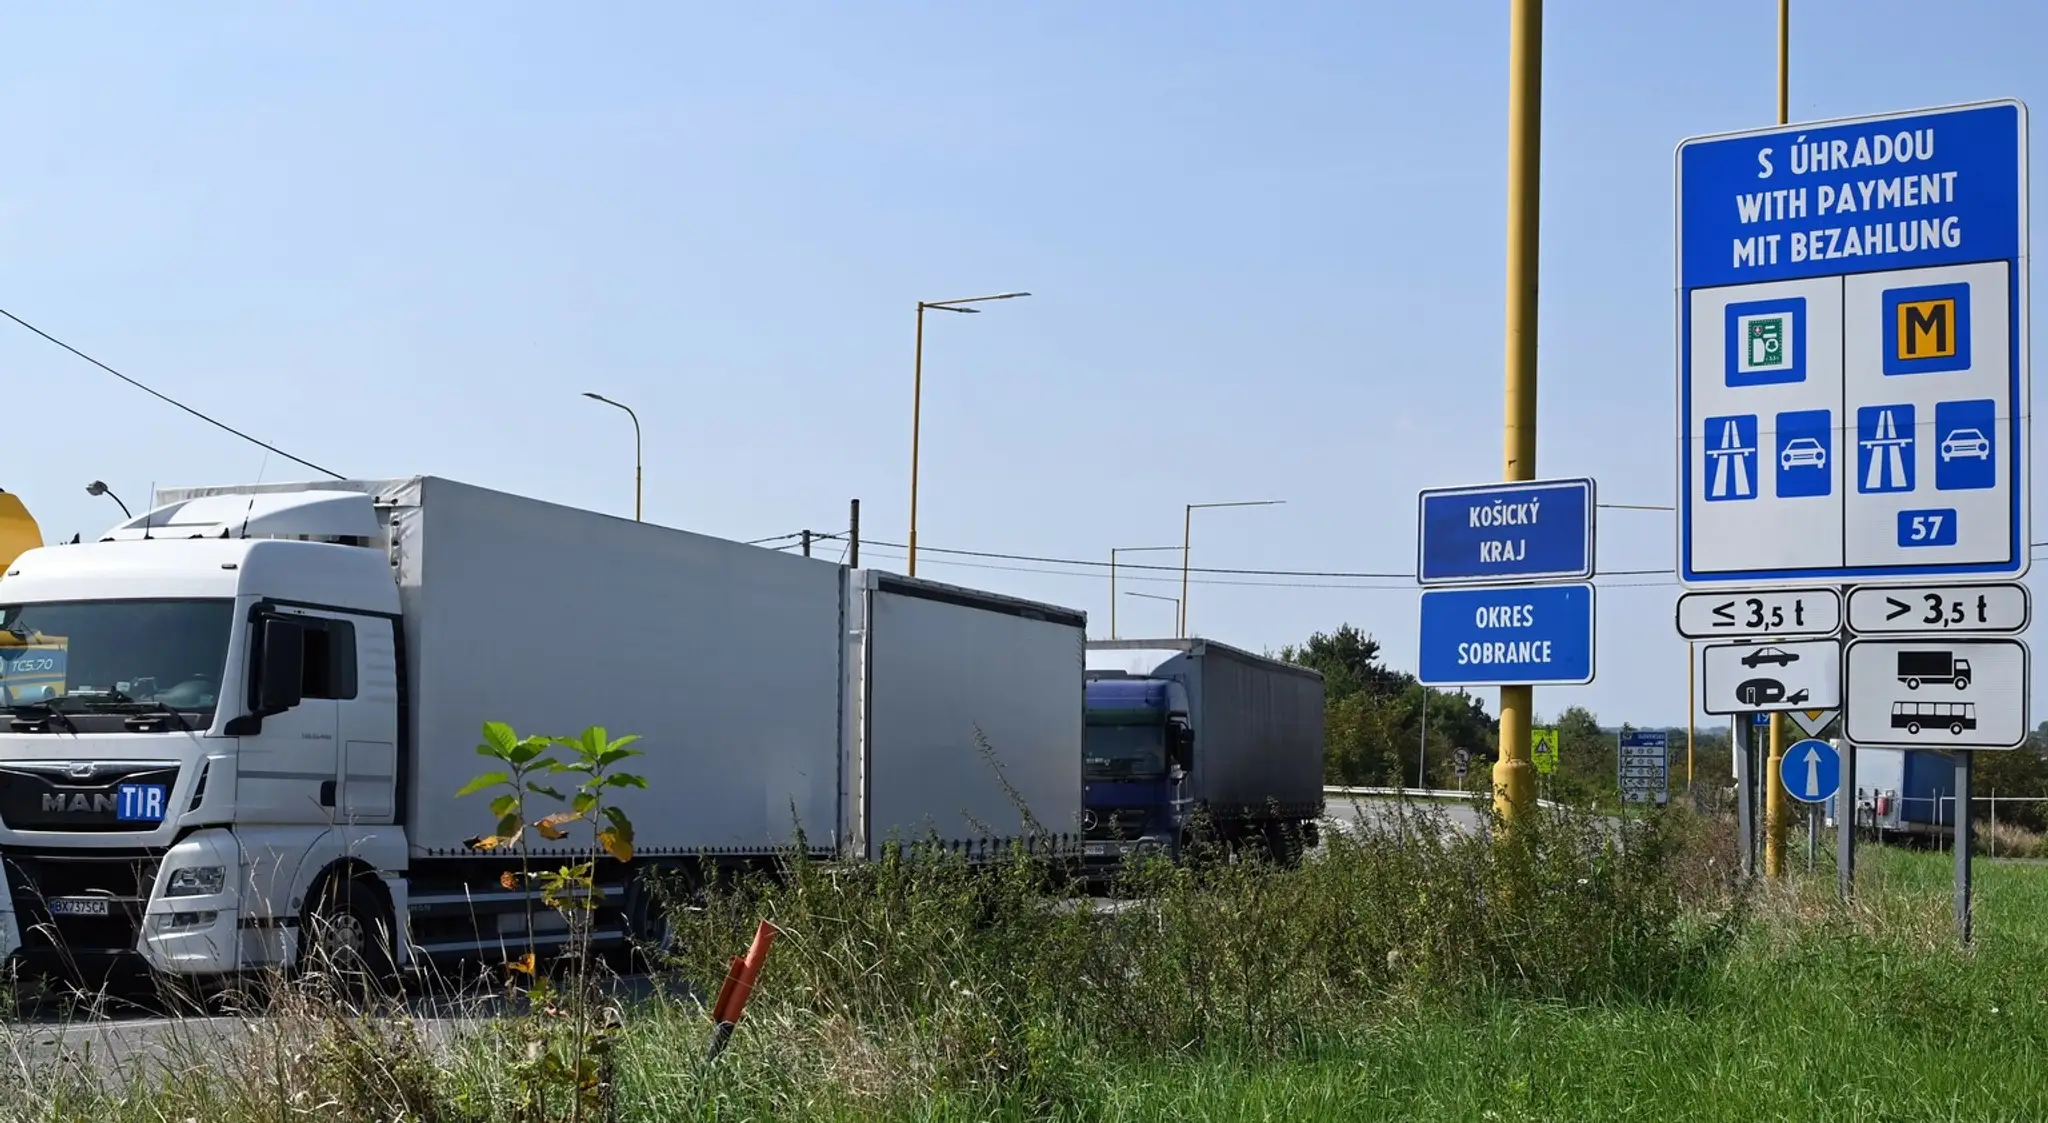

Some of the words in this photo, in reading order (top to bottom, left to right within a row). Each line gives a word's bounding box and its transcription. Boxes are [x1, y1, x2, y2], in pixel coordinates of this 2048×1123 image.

[1758, 148, 1773, 179] S
[1790, 129, 1934, 175] ÚHRADOU
[1736, 187, 1807, 224] WITH
[1818, 171, 1958, 215] PAYMENT
[1733, 235, 1781, 268] MIT
[1791, 216, 1961, 263] BEZAHLUNG
[1905, 304, 1946, 354] M
[1469, 497, 1540, 528] KOŠICKÝ
[1911, 516, 1943, 540] 57
[1480, 539, 1526, 563] KRAJ
[1475, 604, 1534, 628] OKRES
[1745, 599, 1784, 631] 3,5
[1795, 600, 1804, 626] t
[1923, 594, 1965, 627] 3,5
[1977, 595, 1987, 623] t
[1458, 641, 1552, 665] SOBRANCE
[42, 793, 118, 812] MAN
[122, 787, 161, 817] TIR
